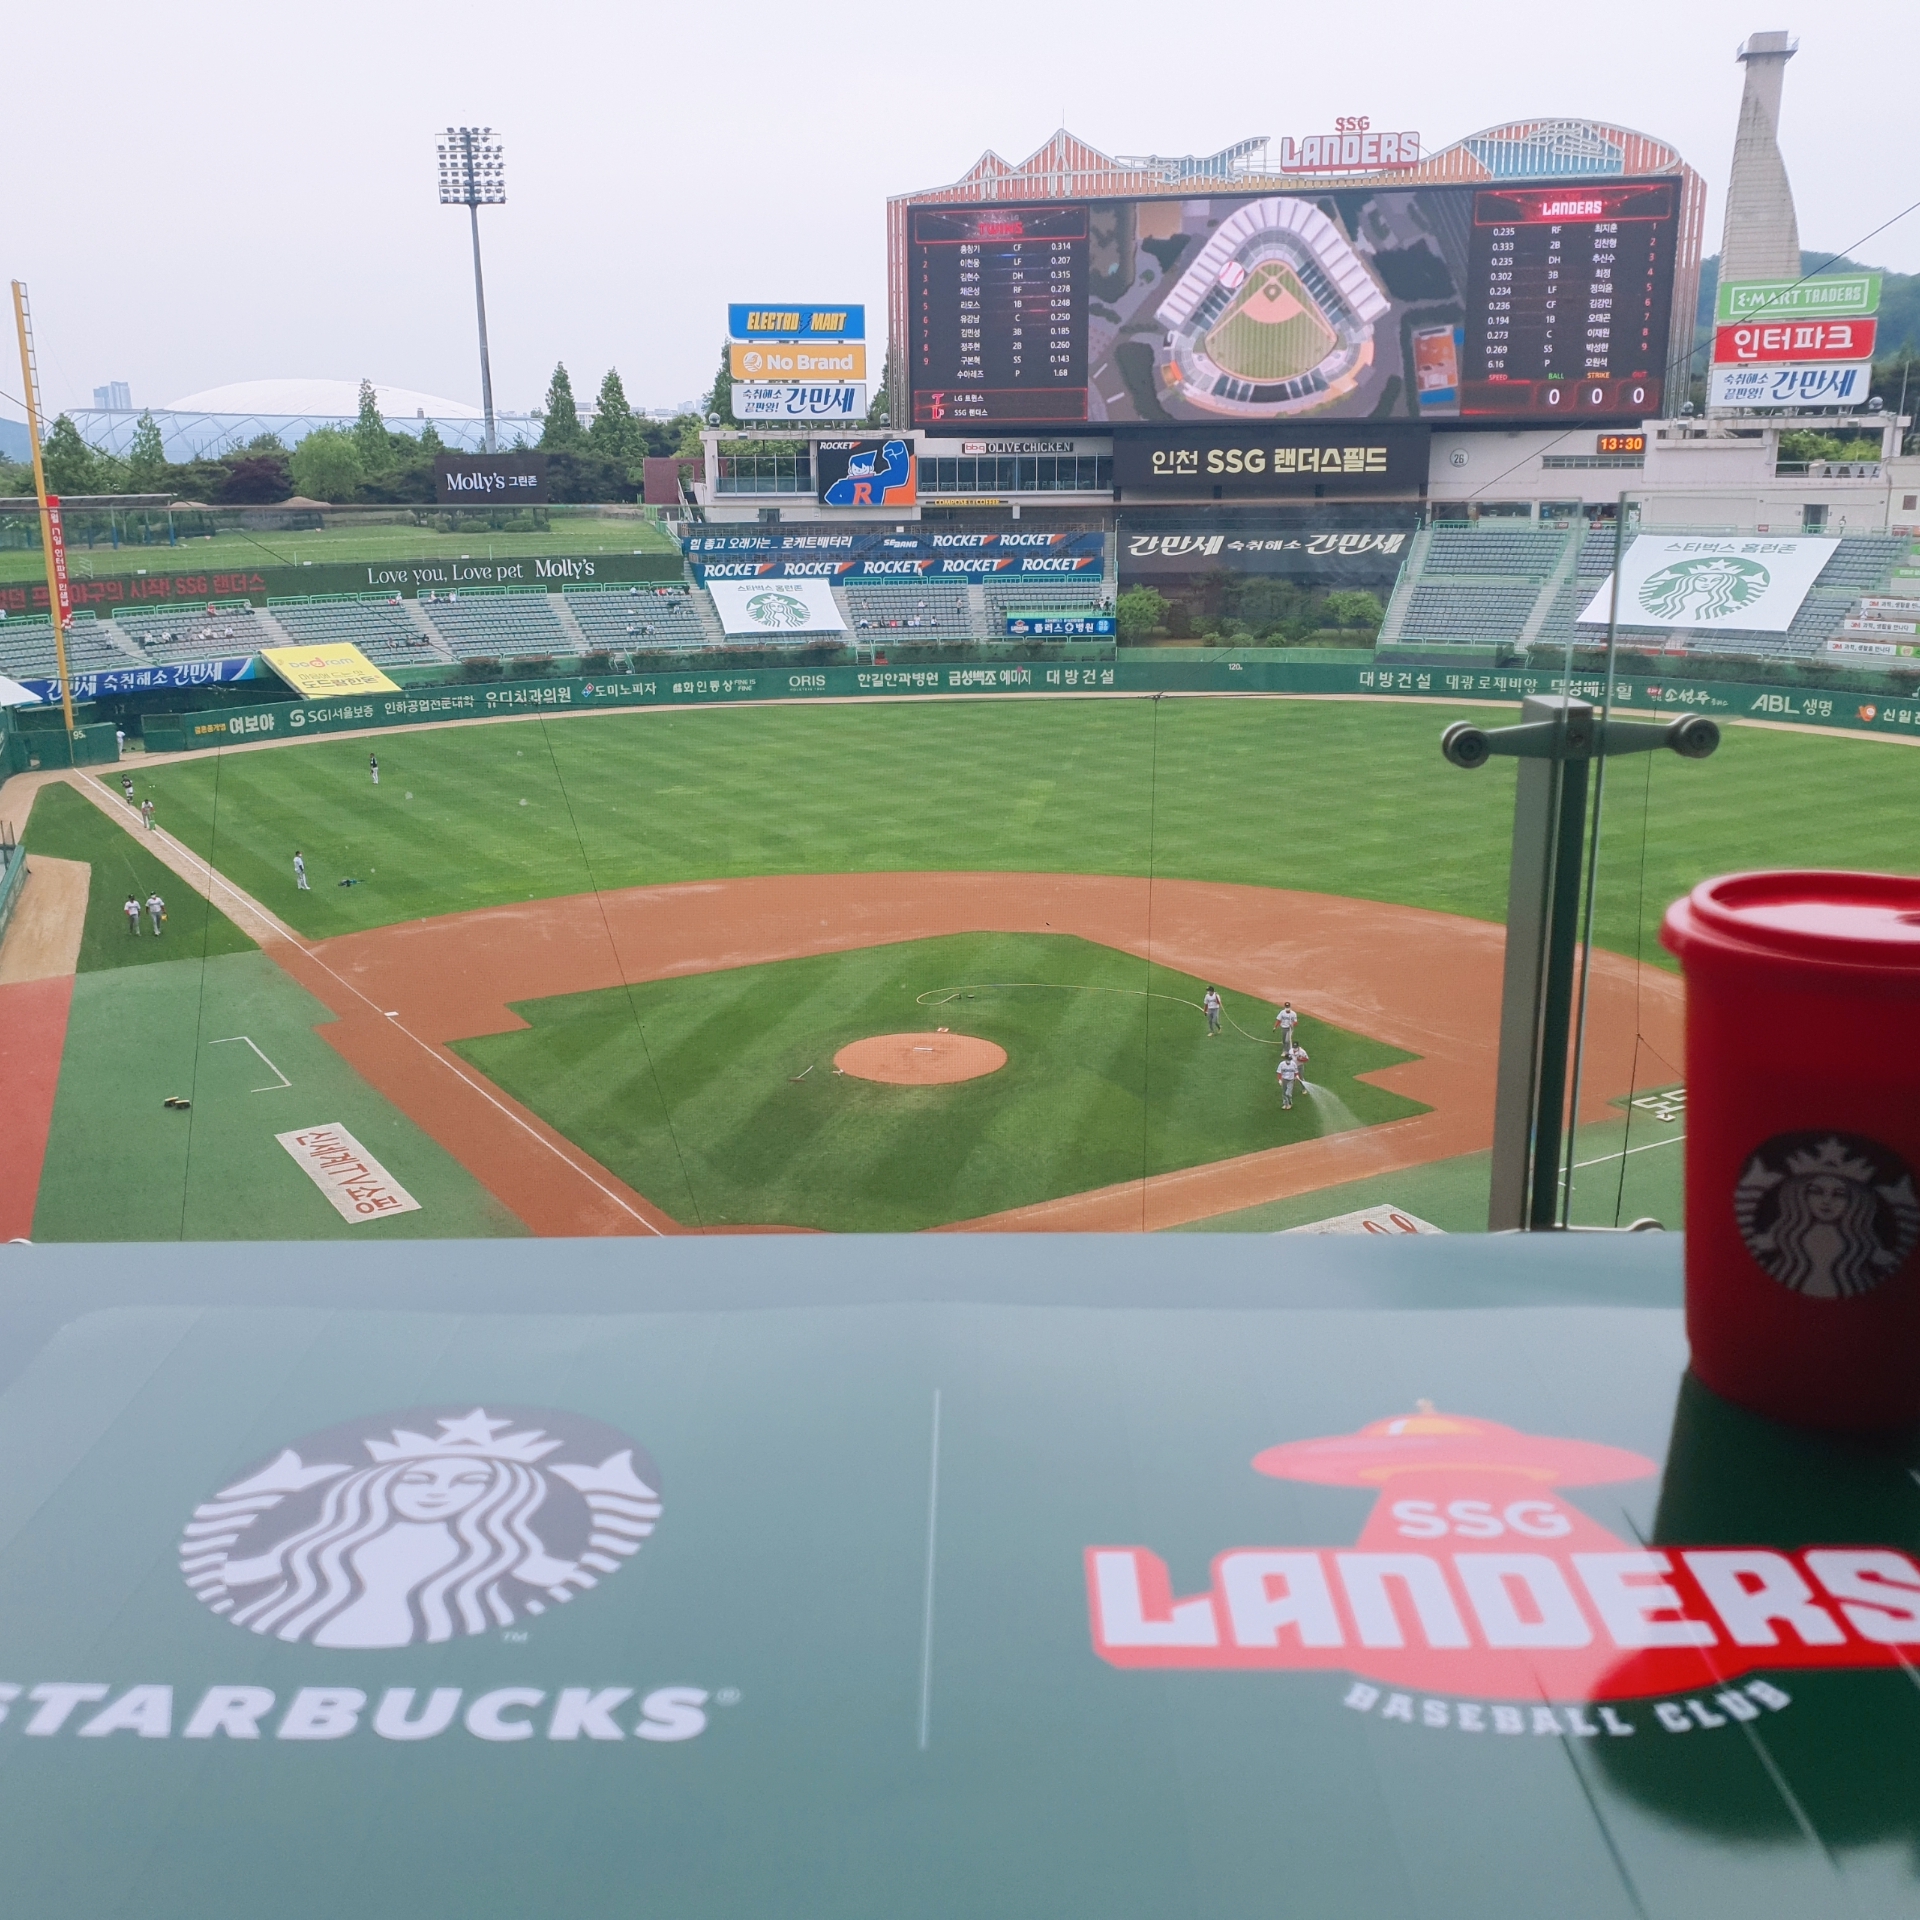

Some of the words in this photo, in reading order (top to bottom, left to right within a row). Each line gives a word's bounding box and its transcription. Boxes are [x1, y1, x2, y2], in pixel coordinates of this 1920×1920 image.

[1335, 116, 1370, 131] SSG
[1282, 132, 1419, 169] LANDERS
[1543, 201, 1602, 215] LANDERS
[979, 222, 1024, 235] TWINS
[1494, 228, 1514, 236] 0.235
[1552, 226, 1561, 234] RF
[1493, 243, 1514, 251] 0.333
[1550, 241, 1560, 249] 2B
[1492, 258, 1513, 266] 0.235
[1549, 256, 1560, 264] DH
[1013, 272, 1023, 280] DH
[1491, 273, 1512, 281] 0.302
[1548, 271, 1558, 279] 3B
[1013, 286, 1022, 294] RF
[1490, 287, 1511, 296] 0.234
[1805, 287, 1861, 303] TRADERS
[1014, 300, 1022, 308] 1B
[1489, 302, 1510, 310] 0.236
[747, 312, 800, 331] ELECTRO
[811, 312, 847, 332] MART
[1051, 313, 1070, 321] 0.250
[1488, 317, 1509, 325] 0.194
[1013, 328, 1022, 336] 3B
[1051, 327, 1070, 335] 0.185
[1487, 331, 1508, 339] 0.273
[1013, 342, 1022, 350] 2B
[1050, 341, 1070, 349] 0.260
[1486, 346, 1507, 354] 0.269
[1544, 345, 1552, 353] SS
[1734, 326, 1853, 358] 인터파크
[767, 355, 794, 370] No
[797, 354, 853, 370] Brand
[1050, 355, 1070, 363] 0.143
[1488, 360, 1504, 368] 6.16
[1724, 373, 1769, 385] 숙취해소
[1770, 369, 1858, 400] 간만세
[742, 388, 782, 399] 숙취해소
[785, 388, 855, 414] 간만세
[1549, 388, 1560, 404] 0
[1592, 388, 1603, 404] 0
[1633, 388, 1644, 403] 0
[1724, 388, 1764, 400] 끝판왕!
[745, 402, 779, 413] 끝판왕!
[820, 442, 855, 450] ROCKET
[988, 442, 1021, 453] OLIVE
[1023, 442, 1071, 452] CHICKEN
[1601, 438, 1642, 450] 13:30
[1152, 450, 1198, 474] 인천
[1206, 449, 1265, 473] SSG
[1274, 447, 1387, 473] 랜더스필드
[1454, 454, 1464, 464] 26
[446, 472, 505, 493] Molly's
[509, 476, 538, 487] 그린존
[853, 482, 872, 504] R
[690, 538, 701, 550] 힘
[704, 538, 725, 550] 좋고
[782, 536, 853, 548] 로케트배터리
[884, 539, 918, 548] SEBANG
[933, 534, 988, 546] ROCKET
[1000, 534, 1055, 545] ROCKET
[1128, 535, 1224, 556] 간만세
[1227, 539, 1302, 550] 숙취해소
[1304, 534, 1406, 555] 간만세
[1664, 542, 1735, 553] 스타벅스
[1741, 543, 1797, 554] 홈런존
[54, 548, 66, 579] 인터파크
[704, 563, 763, 577] ROCKET
[784, 562, 843, 576] ROCKET
[863, 562, 922, 574] ROCKET
[942, 560, 1001, 572] ROCKET
[1022, 558, 1082, 571] ROCKET
[368, 567, 408, 584] Love
[412, 568, 448, 585] you,
[453, 564, 492, 580] Love
[497, 564, 523, 582] pet
[535, 558, 595, 579] Molly's
[32, 580, 124, 608] 프야구의
[130, 578, 171, 598] 시작!
[176, 577, 207, 595] SSG
[213, 574, 266, 594] 랜더스
[1075, 623, 1094, 633] 병원
[104, 672, 168, 691] 숙취해소
[173, 662, 222, 685] 간만세
[789, 675, 826, 687] ORIS
[858, 672, 939, 687] 한길안과병원
[949, 670, 996, 686] 금성백조
[1000, 669, 1031, 686] 예미지
[1047, 669, 1114, 685] 대방건설
[1359, 671, 1431, 689] 대방건설
[1446, 675, 1474, 690] 대광
[1478, 676, 1538, 693] 로제비앙
[595, 682, 656, 697] 도미노피자
[1665, 689, 1711, 704] 소성주
[384, 695, 474, 715] 인하공업전문대학
[486, 687, 571, 708] 유디치과의원
[1751, 694, 1800, 714] ABL
[1803, 699, 1833, 716] 생명
[229, 713, 274, 734] 여보야
[296, 1132, 402, 1214] 신세계TV쇼핑
[1392, 1500, 1574, 1540] SSG
[1089, 1548, 1920, 1649] LANDERS
[1344, 1681, 1635, 1736] BASEBALL
[1654, 1678, 1793, 1732] CLUB
